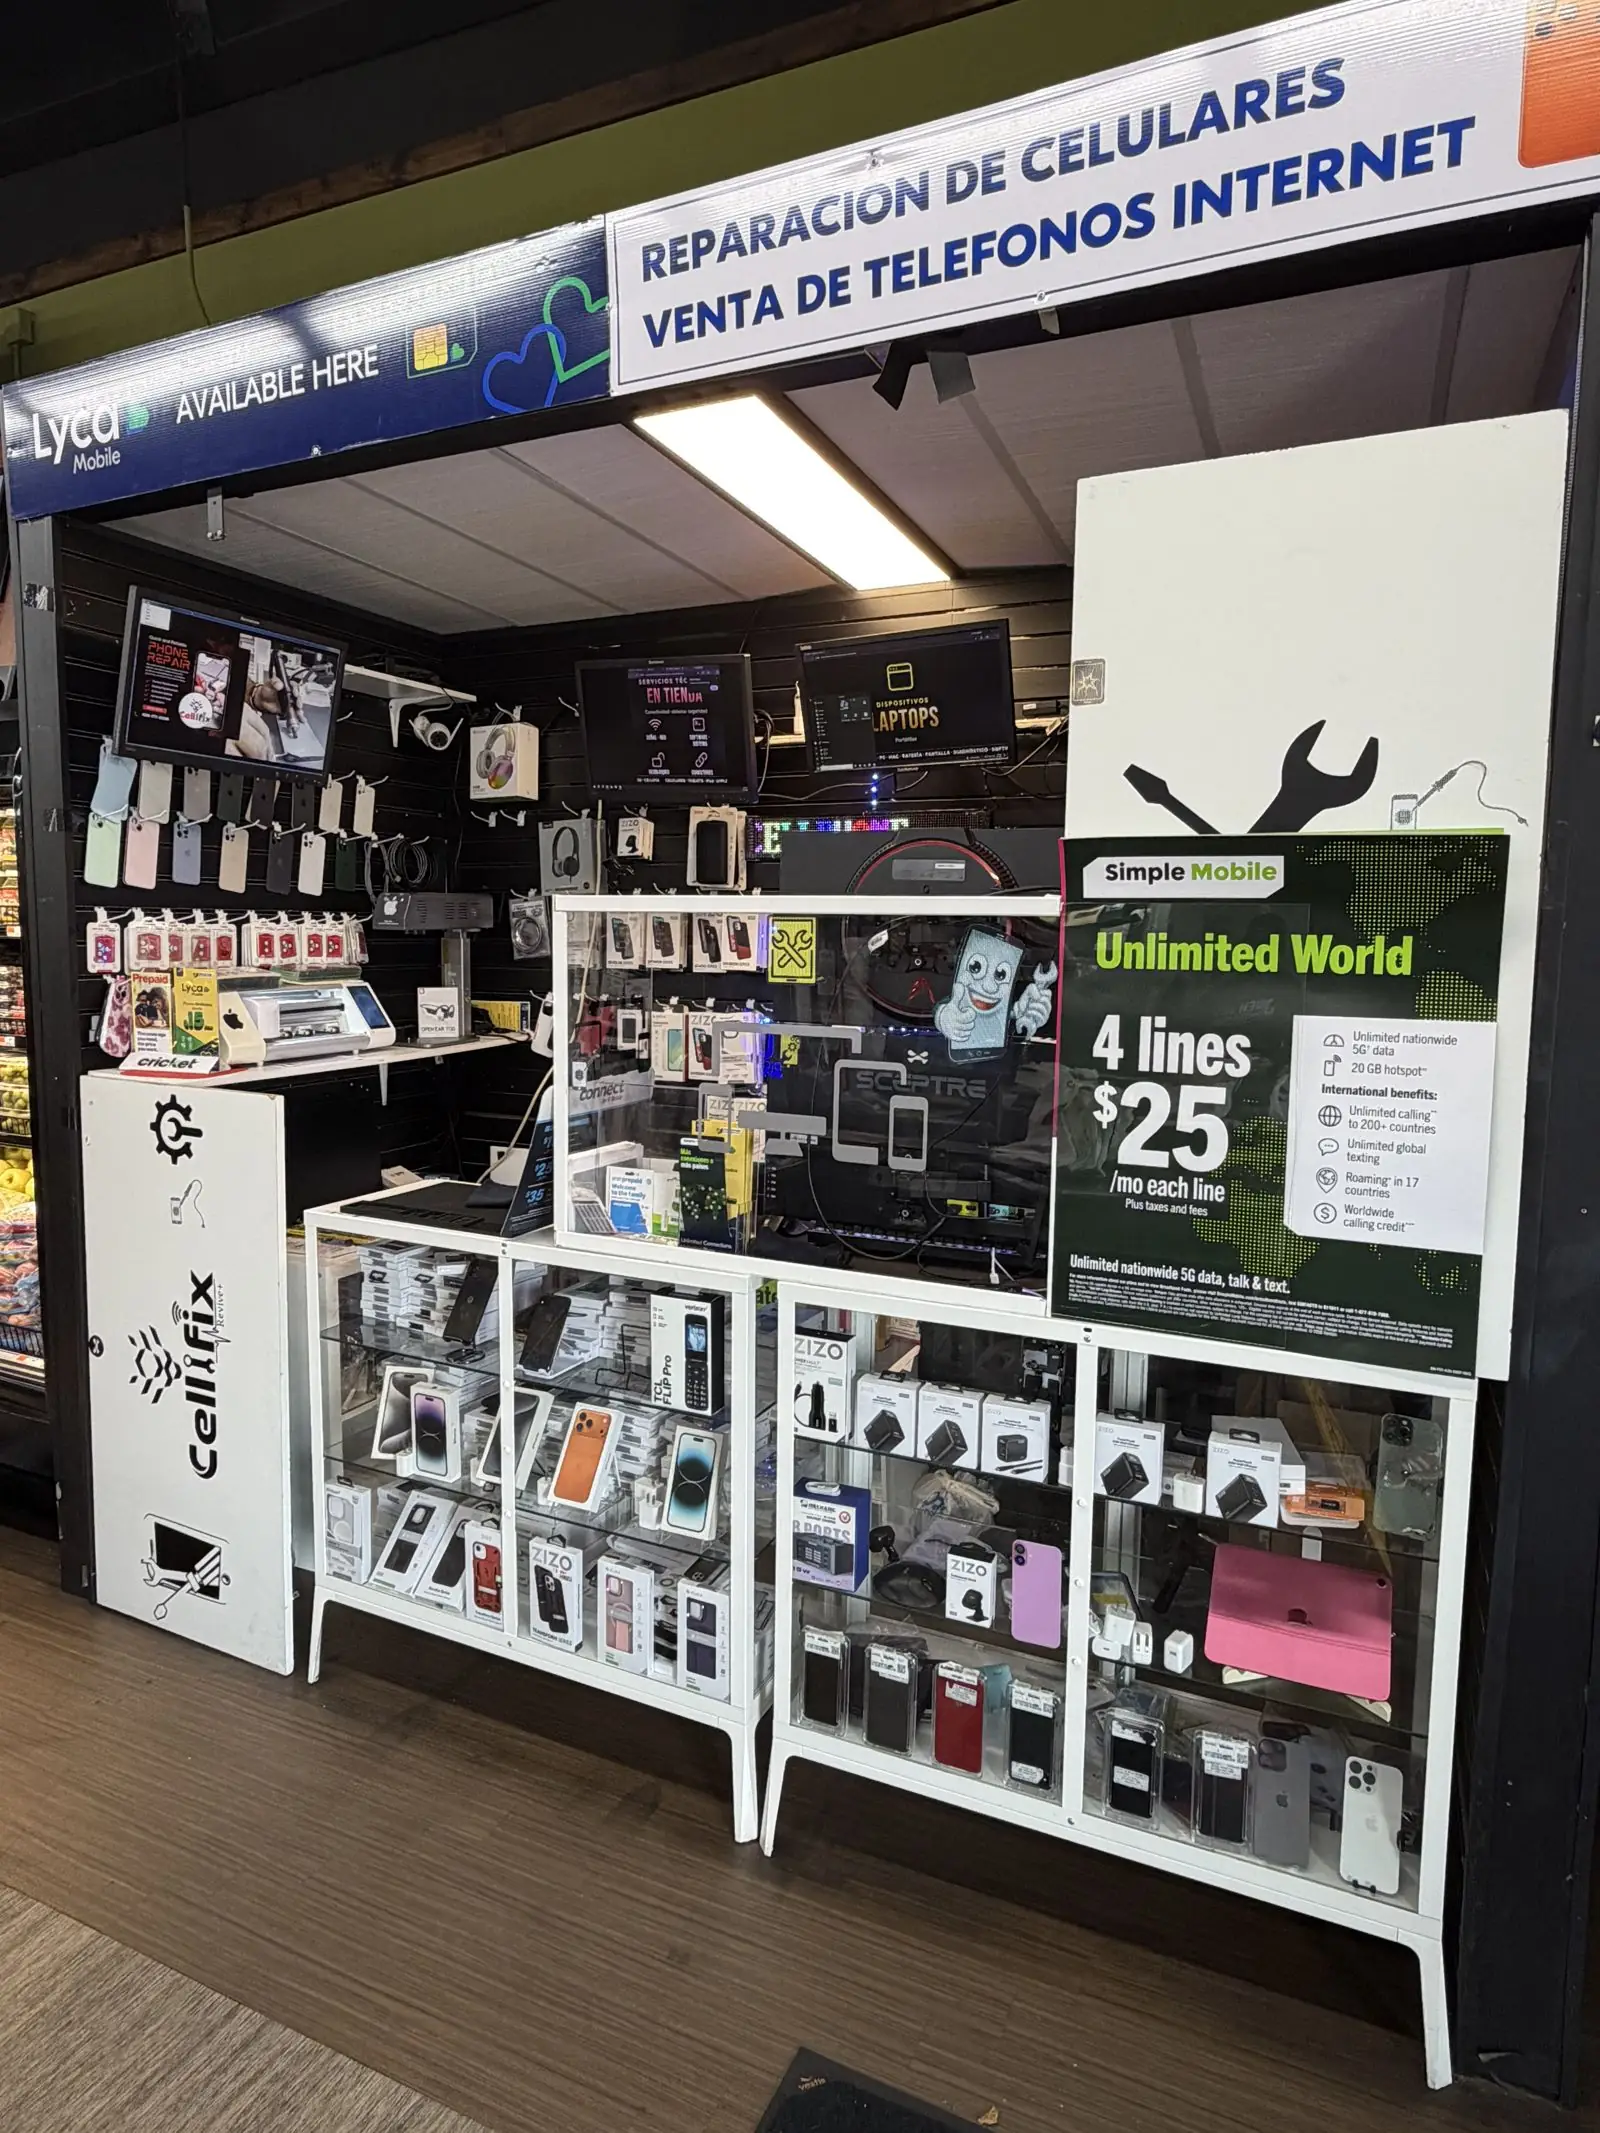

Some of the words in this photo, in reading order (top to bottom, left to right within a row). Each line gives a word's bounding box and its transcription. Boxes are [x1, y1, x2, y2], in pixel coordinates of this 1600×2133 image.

[642, 171, 930, 283] REPARACION
[945, 150, 1009, 201] DE
[1020, 57, 1347, 185] CELULARES
[643, 284, 785, 349] VENTA
[799, 265, 852, 315] DE
[864, 193, 1157, 300] TELEFONOS
[1173, 115, 1478, 233] INTERNET
[176, 372, 305, 424] AVAILABLE
[313, 345, 379, 392] HERE
[32, 401, 121, 465] Lyca
[73, 448, 121, 475] Mobile
[148, 641, 189, 659] PHONE
[147, 652, 190, 671] REPAIR
[646, 687, 660, 703] EN
[876, 697, 929, 708] DISPOSITIVOS
[1105, 862, 1186, 884] Simple
[1191, 862, 1278, 882] Mobile
[1095, 931, 1280, 974] Unlimited
[1291, 933, 1414, 976] World
[133, 973, 168, 984] Prepaid
[181, 983, 203, 993] Lyca
[1092, 1014, 1124, 1070] 4
[1138, 1016, 1252, 1078] lines
[1353, 1031, 1400, 1044] Unlimited
[1402, 1033, 1457, 1046] nationwide
[1372, 1045, 1395, 1056] data
[137, 1057, 199, 1069] cricket
[1351, 1062, 1365, 1073] 20
[1367, 1063, 1382, 1074] GB
[580, 1080, 625, 1101] connect
[857, 1070, 987, 1099] SCEPTRE
[1321, 1083, 1388, 1098] International
[1391, 1087, 1438, 1101] benefits:
[1349, 1105, 1396, 1119] Unlimited
[1092, 1080, 1230, 1173] $25
[1348, 1119, 1359, 1129] to
[1360, 1119, 1387, 1131] 200+
[1389, 1122, 1436, 1135] countries
[1347, 1138, 1394, 1152] Unlimited
[1396, 1141, 1426, 1155] global
[1346, 1152, 1380, 1165] texting
[1109, 1170, 1143, 1195] /mo
[1147, 1175, 1189, 1199] each
[1193, 1177, 1226, 1203] line
[1394, 1175, 1403, 1187] in
[1406, 1177, 1419, 1188] 17
[1344, 1186, 1390, 1199] countries
[1125, 1198, 1144, 1211] Plus
[1145, 1200, 1169, 1212] taxes
[1170, 1202, 1187, 1215] and
[1189, 1204, 1208, 1217] fees
[1344, 1204, 1394, 1218] Worldwide
[1343, 1218, 1375, 1232] calling
[1070, 1254, 1119, 1273] Unlimited
[1120, 1261, 1178, 1281] nationwide
[1180, 1267, 1195, 1282] 5G
[1198, 1270, 1226, 1288] data,
[1228, 1273, 1250, 1289] talk
[1252, 1276, 1262, 1290] &
[1264, 1278, 1291, 1294] text.
[795, 1337, 843, 1361] ZIZO
[662, 1355, 672, 1377] Pro
[654, 1379, 663, 1403] TCL
[662, 1377, 672, 1405] FLIP
[532, 1546, 573, 1571] ZIZO
[951, 1559, 987, 1577] ZIZO
